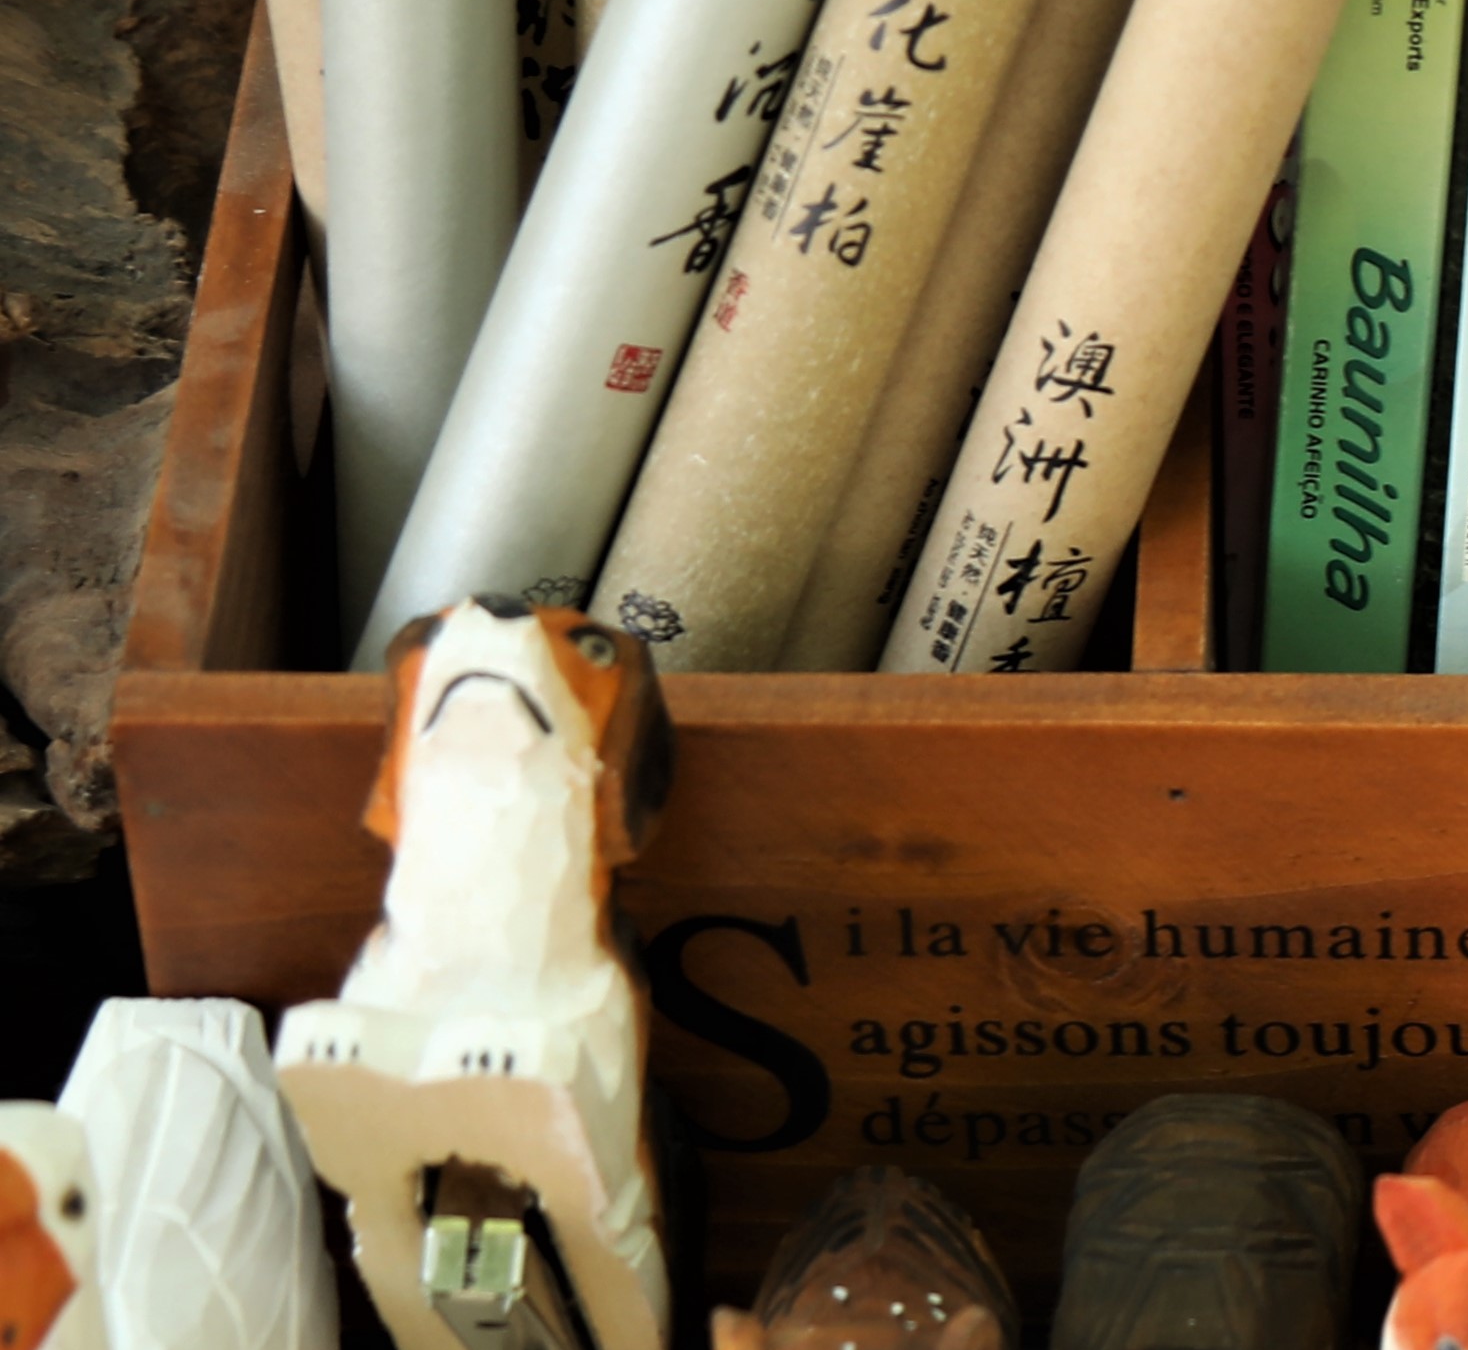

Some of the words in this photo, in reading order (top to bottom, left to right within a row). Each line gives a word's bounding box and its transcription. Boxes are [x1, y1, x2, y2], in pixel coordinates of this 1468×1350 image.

[1307, 338, 1331, 428] CARINHO
[1323, 249, 1416, 613] Baunilha
[1295, 433, 1327, 519] AFEIÇÃO
[898, 907, 969, 960] la
[994, 910, 1120, 960] vie
[848, 1003, 1192, 1077] agissons
